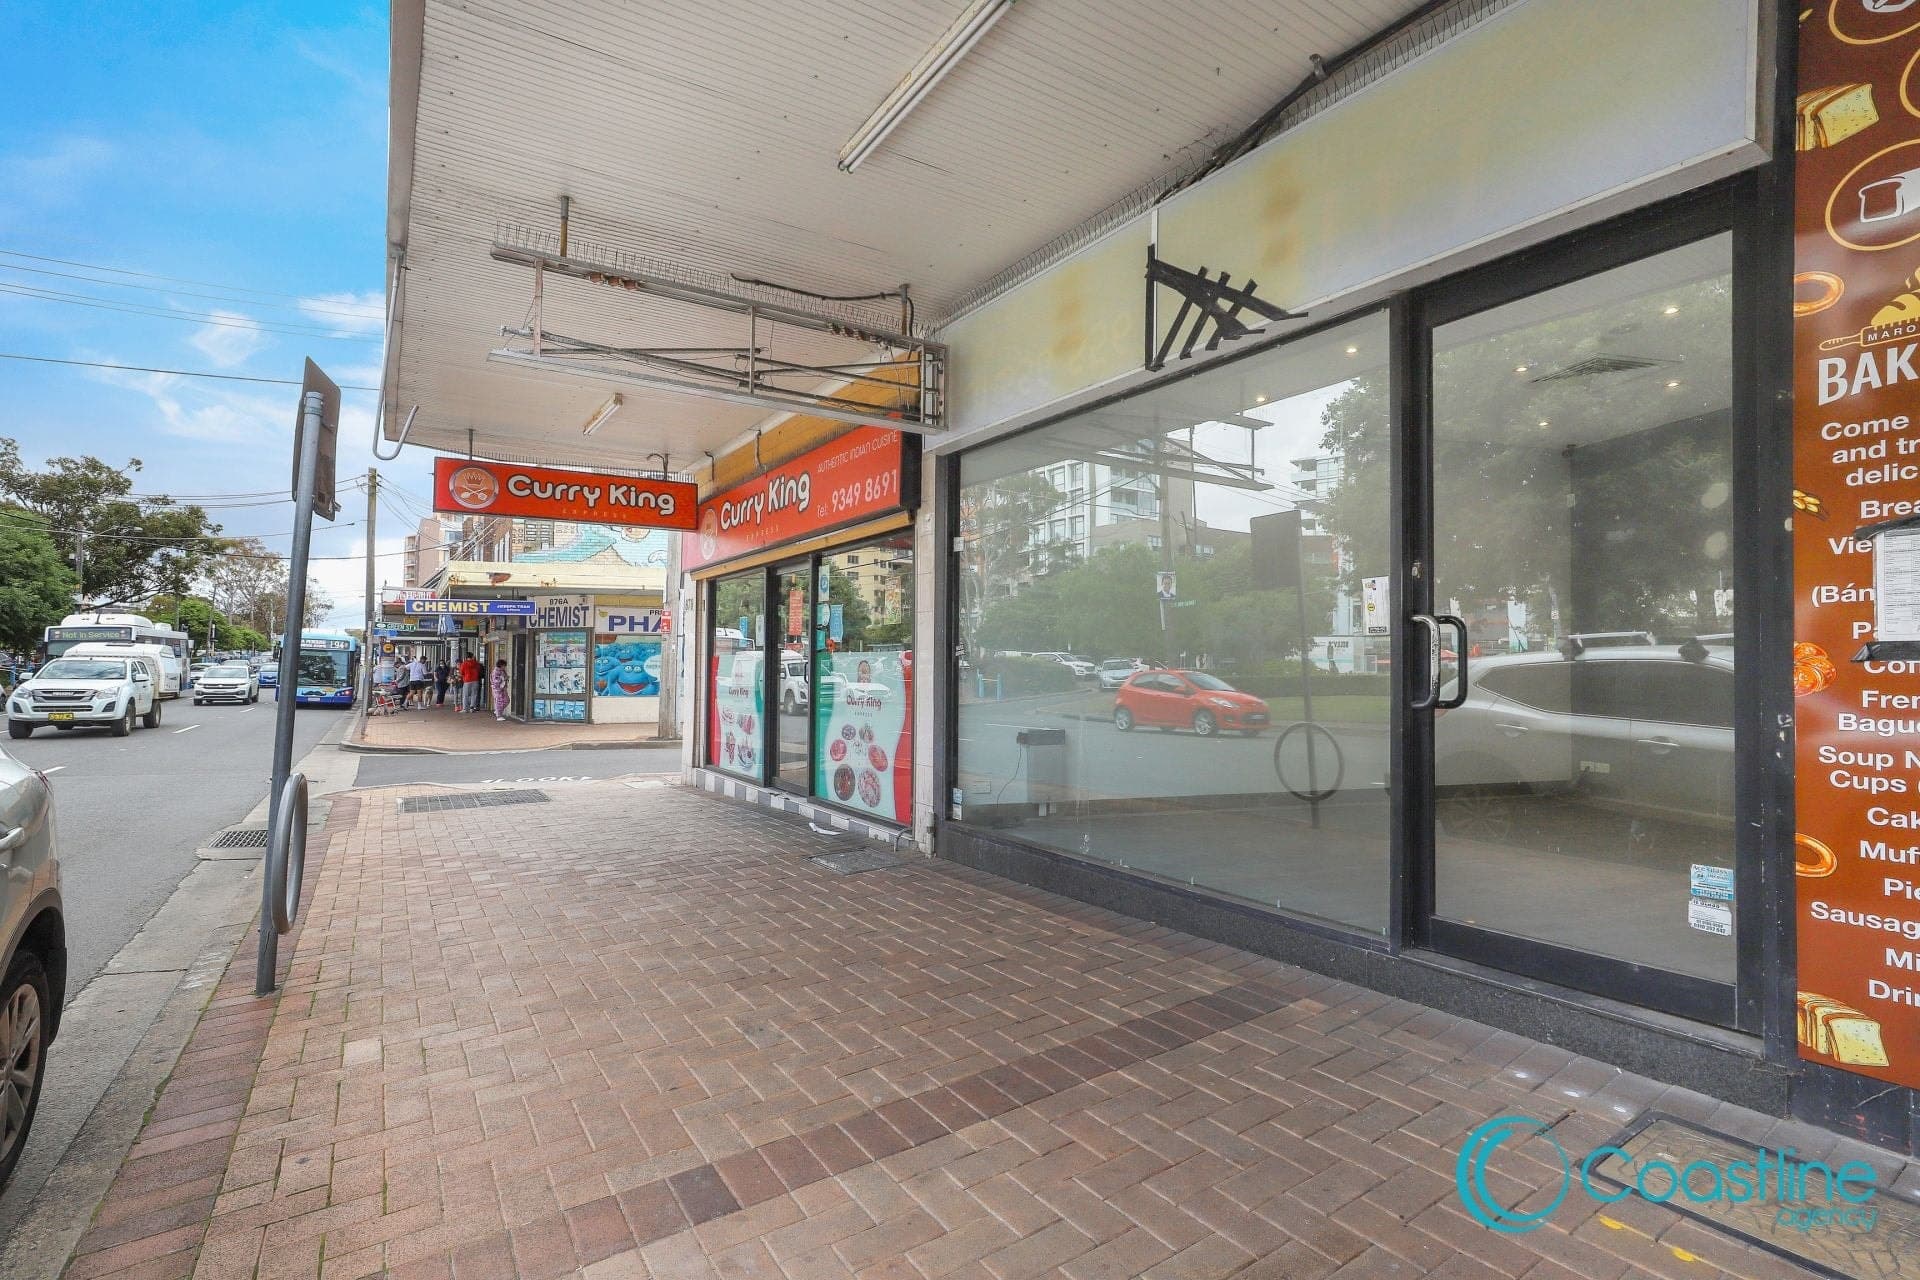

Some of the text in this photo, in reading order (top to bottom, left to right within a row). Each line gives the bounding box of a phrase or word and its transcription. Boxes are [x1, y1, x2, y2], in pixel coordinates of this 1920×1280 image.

[1867, 324, 1917, 342] MARO
[1818, 342, 1919, 406] BAK
[1821, 415, 1910, 441] Come
[817, 430, 898, 473] AUTHENTIC INDIAN CUISINE
[1831, 438, 1887, 464] and
[1845, 462, 1919, 487] delic
[507, 473, 676, 516] Curry King
[720, 470, 811, 531] Curry King
[831, 482, 861, 513] 9349
[864, 469, 898, 502] 8691
[1828, 534, 1874, 555] Vie
[411, 600, 490, 613] CHEMIST
[529, 605, 590, 628] CHEMIST
[1852, 621, 1879, 640] P
[1838, 713, 1920, 737] Bagu
[1818, 745, 1894, 771] Soup
[1829, 769, 1908, 795] Cups
[1811, 901, 1920, 939] Sausag
